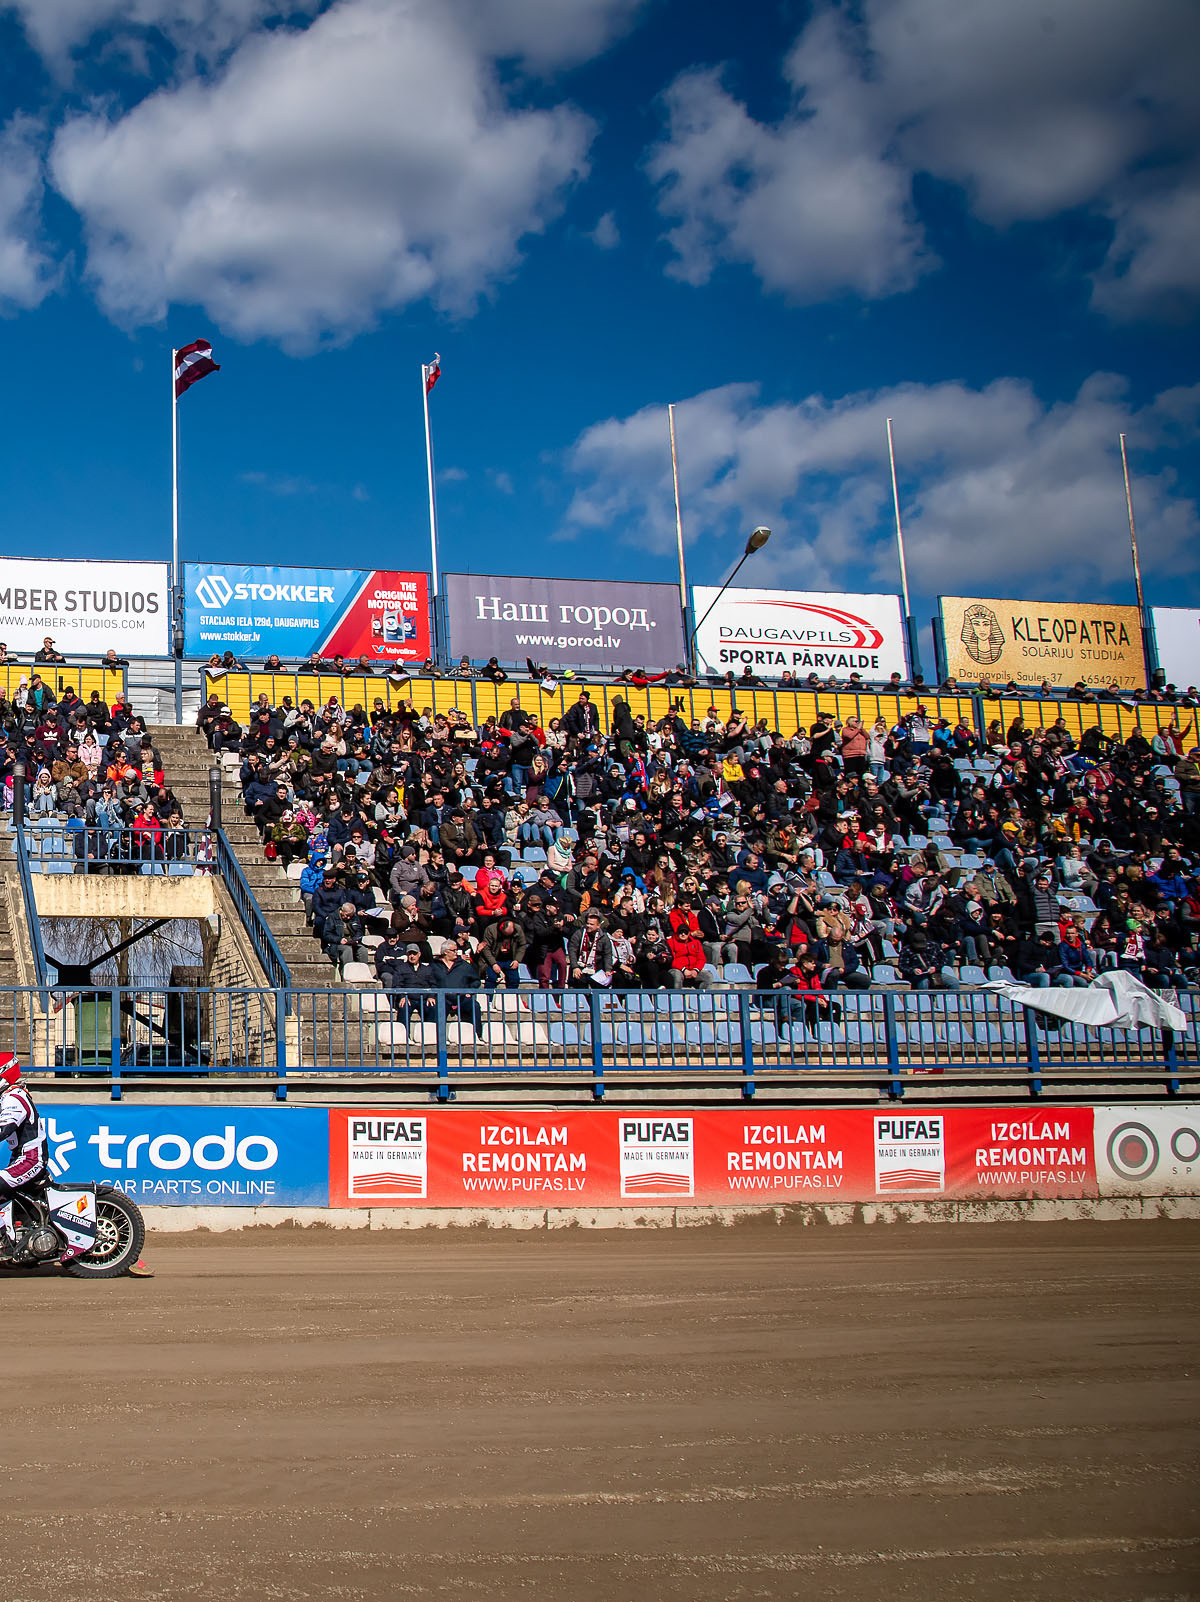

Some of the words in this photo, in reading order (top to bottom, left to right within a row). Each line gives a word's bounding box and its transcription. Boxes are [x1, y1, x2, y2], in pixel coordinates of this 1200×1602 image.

[400, 581, 417, 592] THE
[64, 590, 159, 614] STUDIOS
[374, 590, 418, 601] ORIGINAL
[367, 599, 402, 610] MOTOR
[403, 601, 418, 611] OIL
[475, 595, 549, 623] Наш
[559, 604, 657, 631] город.
[200, 615, 235, 626] STACIJAS
[237, 616, 253, 627] IELA
[274, 617, 320, 628] DAUGAVPILS
[200, 631, 261, 642] www.stokker.lv
[719, 626, 852, 643] DAUGAVPILS
[1011, 616, 1131, 646] KLEOPATRA
[515, 634, 621, 648] www.gorod.lv
[719, 649, 787, 665] SPORTA
[792, 648, 879, 669] PĀRVALDE
[1022, 646, 1074, 659] SOLĀRIJU
[1080, 649, 1125, 661] STUDIJA
[1087, 674, 1136, 686] 65426177
[675, 695, 686, 713] K
[352, 1121, 422, 1142] PUFAS
[480, 1126, 568, 1146] IZCILAM
[623, 1122, 689, 1142] PUFAS
[743, 1125, 826, 1145] IZCILAM
[878, 1120, 940, 1140] PUFAS
[991, 1122, 1070, 1141] IZCILAM
[87, 1125, 279, 1171] trodo
[353, 1151, 375, 1160] MADE
[376, 1151, 384, 1160] IN
[387, 1151, 422, 1160] GERMANY
[624, 1151, 644, 1161] MADE
[646, 1151, 653, 1161] IN
[656, 1151, 689, 1160] GERMANY
[879, 1148, 897, 1158] MADE
[899, 1148, 906, 1158] IN
[909, 1148, 940, 1158] GERMANY
[462, 1153, 587, 1172] REMONTAM
[727, 1151, 843, 1171] REMONTAM
[975, 1147, 1086, 1167] REMONTAM
[463, 1177, 586, 1191] WWW.PUFAS.LV
[728, 1175, 843, 1189] WWW.PUFAS.LV
[977, 1170, 1086, 1185] WWW.PUFAS.LV
[142, 1179, 202, 1194] PARTS
[206, 1180, 276, 1195] ONLINE
